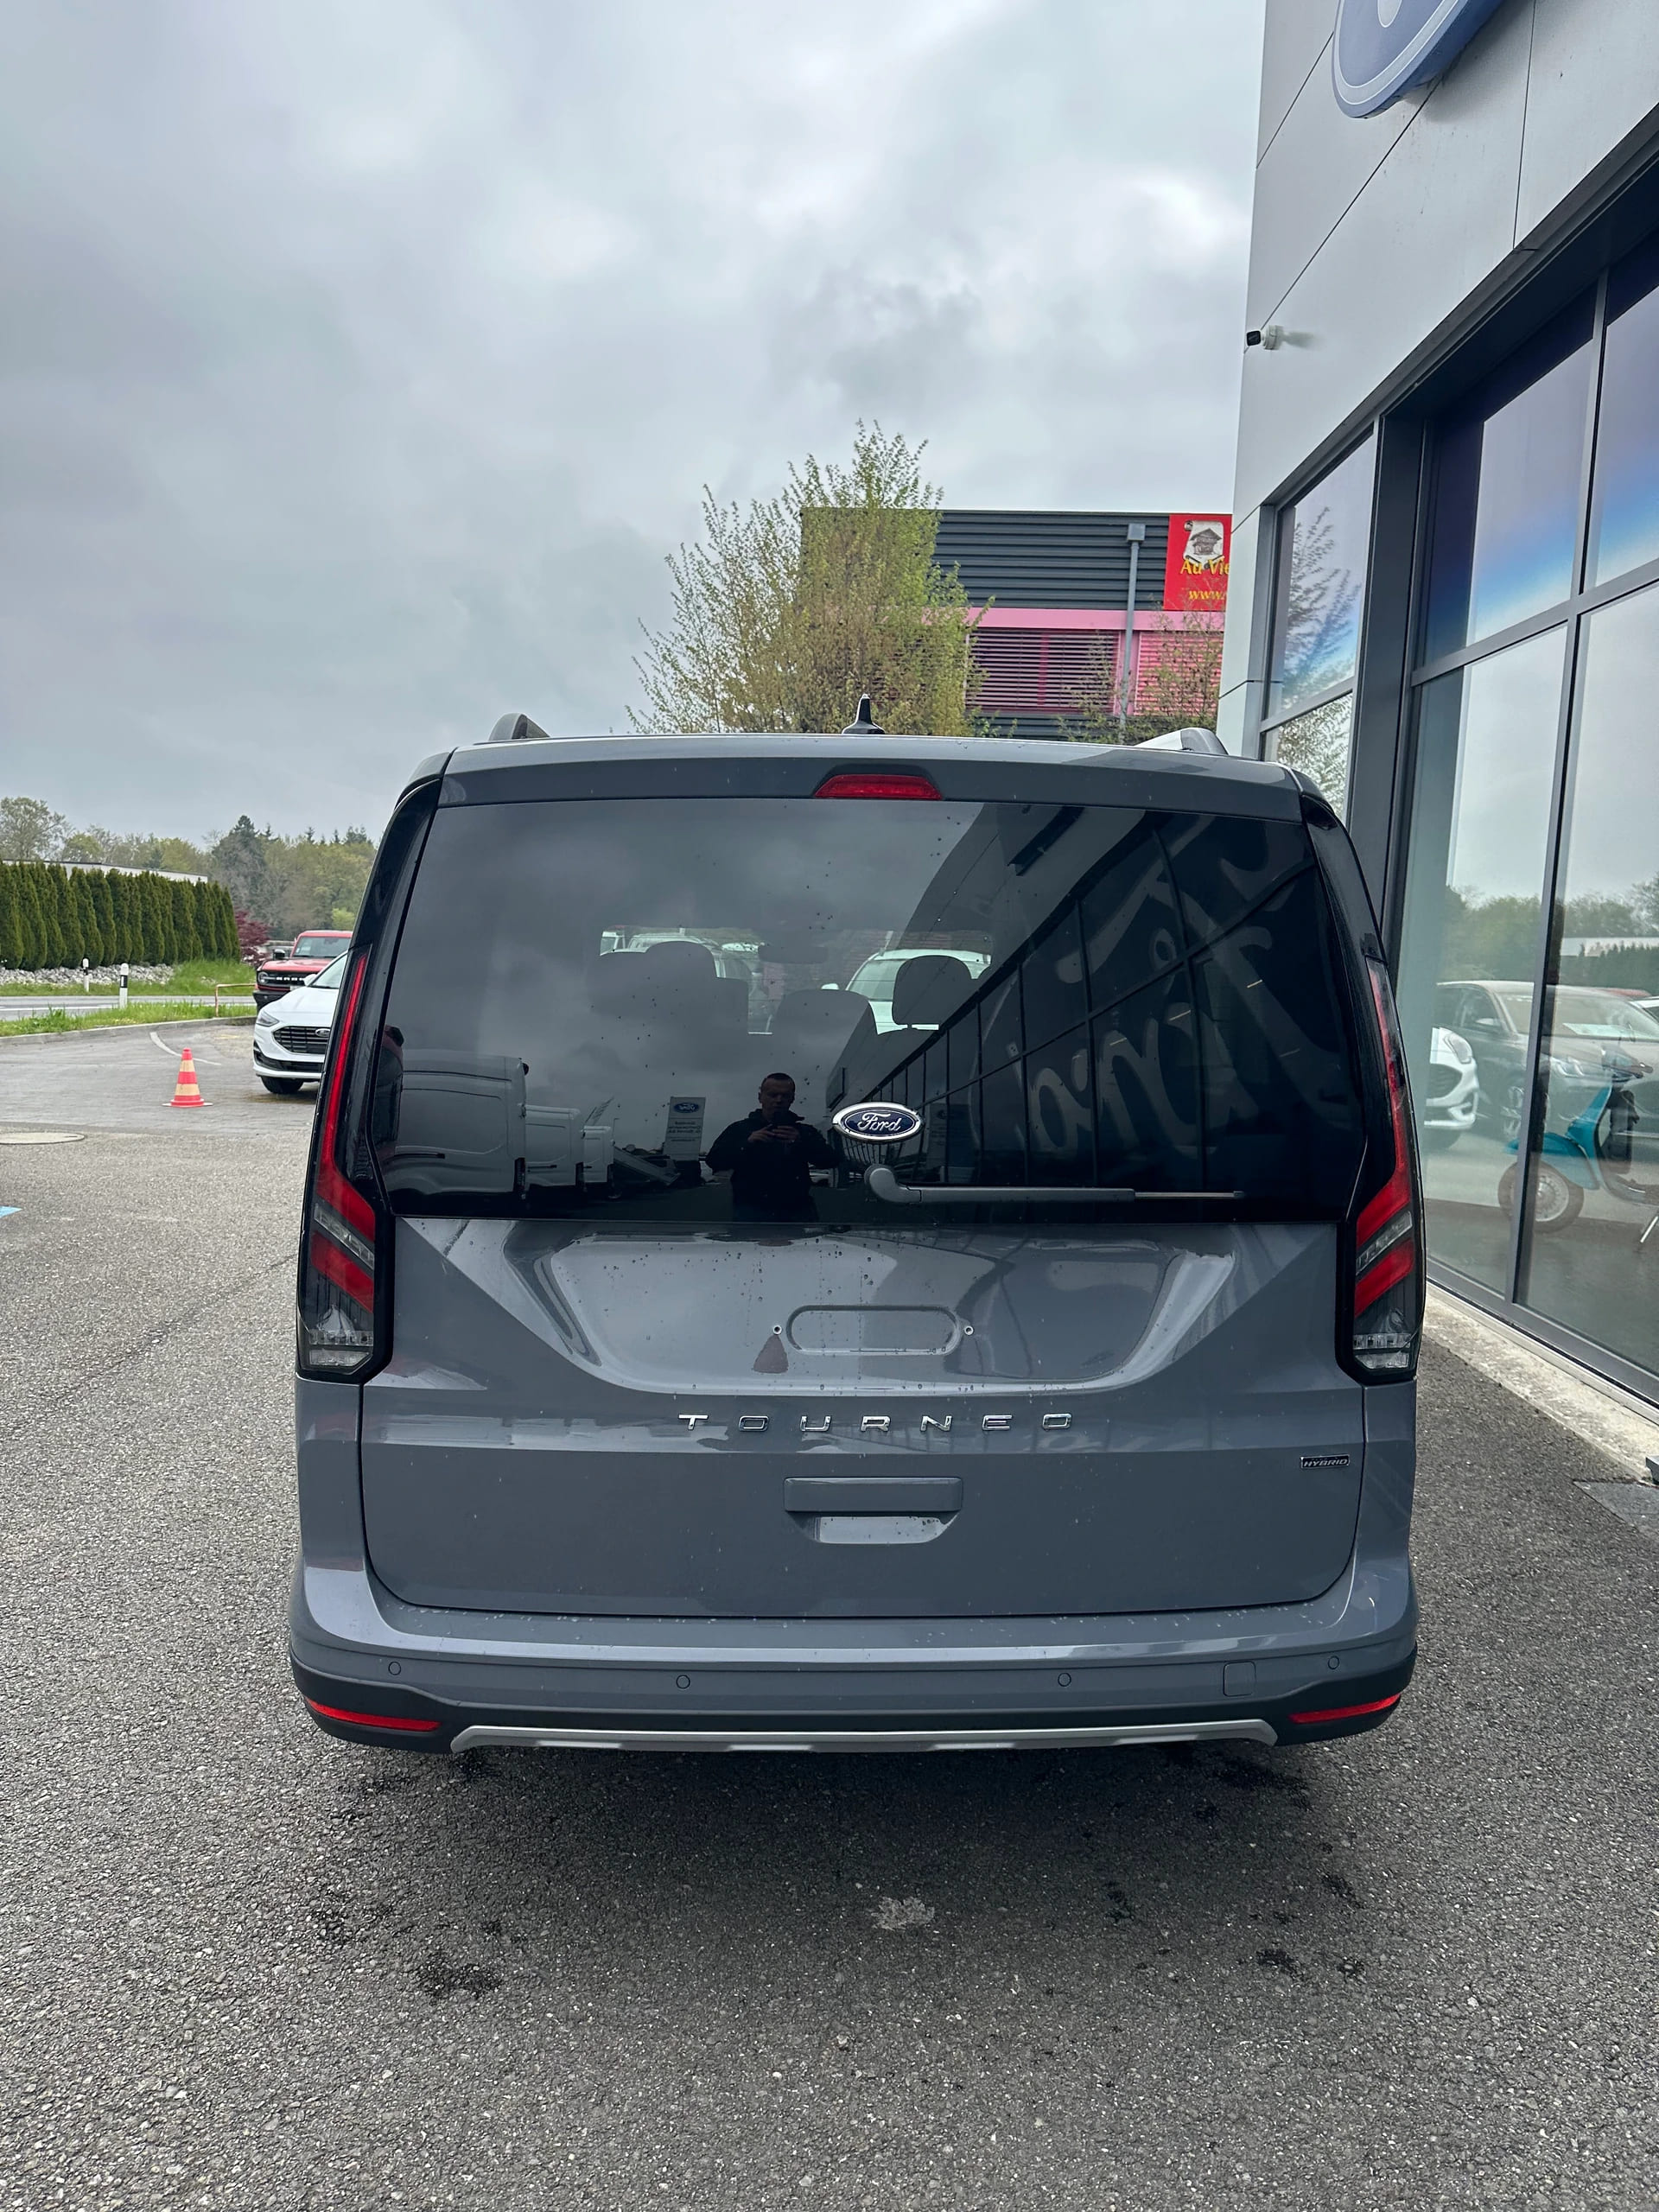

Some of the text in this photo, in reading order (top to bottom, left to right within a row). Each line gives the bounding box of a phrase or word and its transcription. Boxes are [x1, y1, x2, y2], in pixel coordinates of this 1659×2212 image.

[1180, 559, 1202, 575] Au
[857, 1112, 902, 1131] Ford
[678, 1414, 1072, 1432] TOURNEO
[1303, 1459, 1348, 1467] HYBRID
